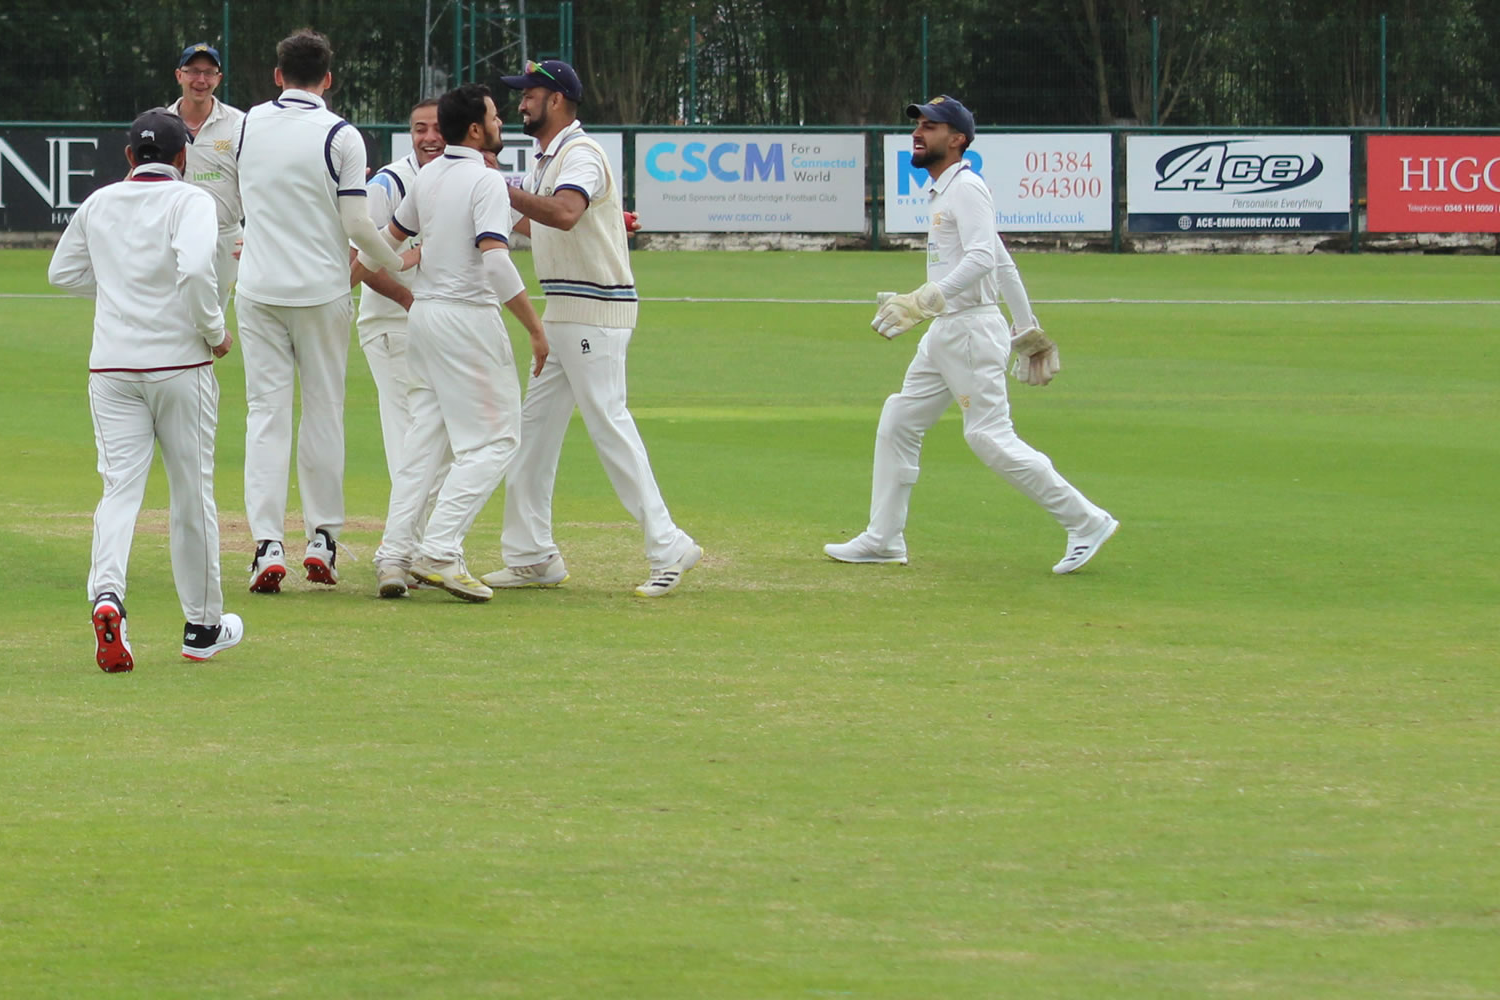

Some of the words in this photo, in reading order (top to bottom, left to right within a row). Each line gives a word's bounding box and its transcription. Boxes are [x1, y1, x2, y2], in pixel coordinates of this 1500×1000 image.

[790, 143, 810, 155] For
[813, 145, 821, 155] a
[645, 142, 786, 183] CSCM
[791, 156, 857, 169] Connected
[1025, 151, 1093, 173] 01384
[1154, 142, 1304, 191] Ace
[793, 171, 831, 183] World
[1017, 176, 1102, 200] 564300
[662, 193, 687, 203] Proud
[688, 193, 726, 204] Sponsors
[727, 193, 736, 203] of
[737, 193, 784, 205] Stourbridge
[785, 193, 817, 203] Football
[818, 193, 838, 203] Club
[1231, 198, 1279, 209] Personalise
[1280, 198, 1323, 211] Everything
[1195, 216, 1301, 229] ACE-EMBROIDERY.CO.UK
